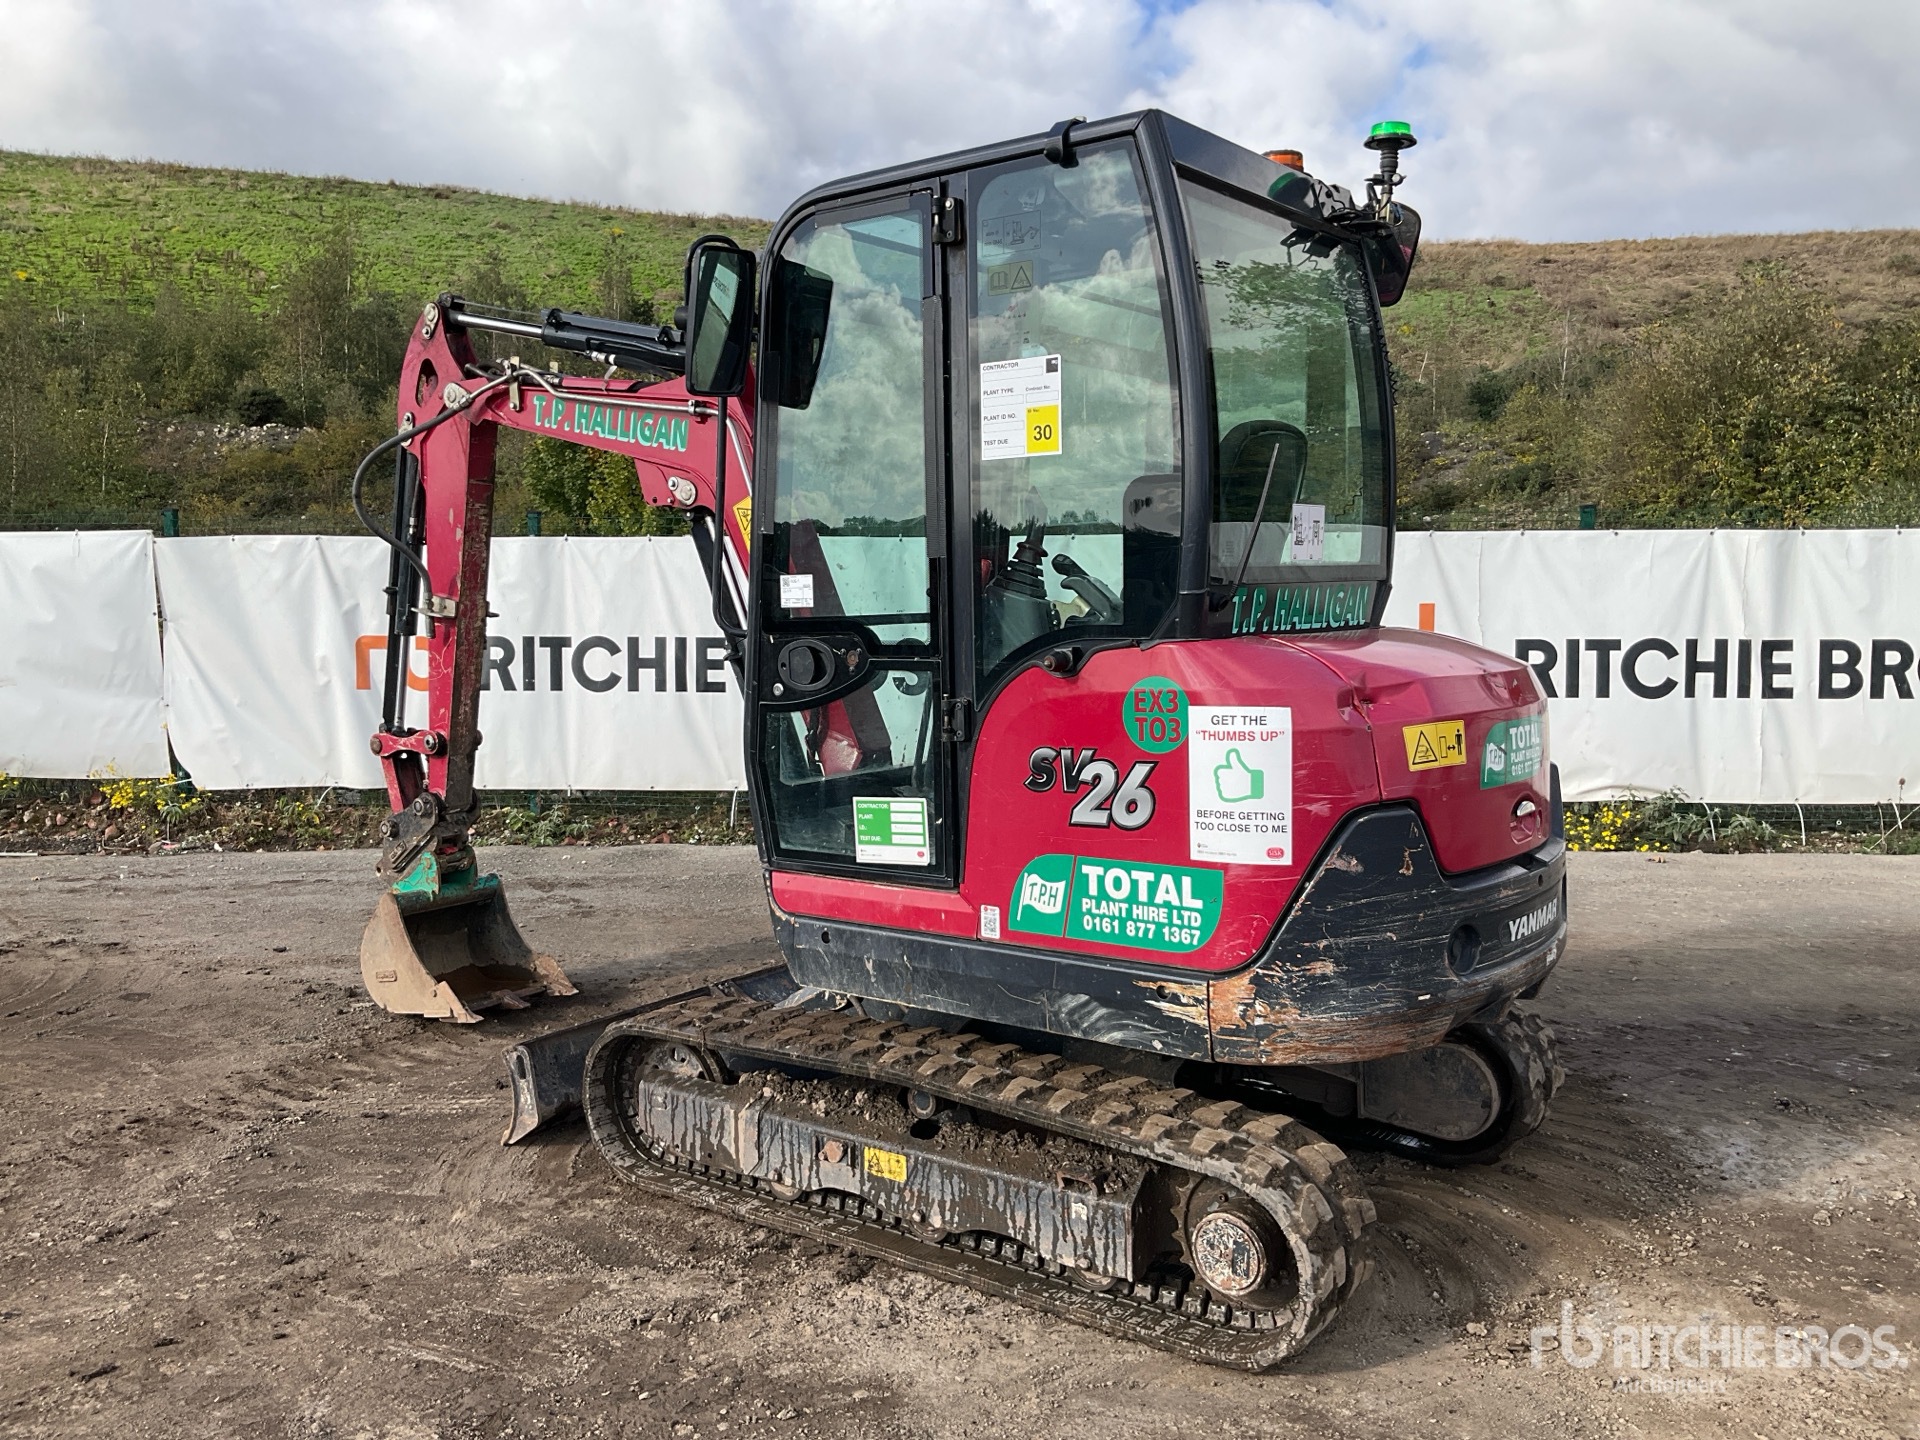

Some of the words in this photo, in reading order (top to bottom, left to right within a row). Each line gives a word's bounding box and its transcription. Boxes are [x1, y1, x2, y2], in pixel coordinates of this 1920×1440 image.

[983, 362, 1018, 371] CONTRACTOR
[534, 396, 570, 430] T.P.
[575, 403, 690, 452] HALLIGAN
[1033, 424, 1052, 441] 30
[1232, 586, 1270, 634] T.P.
[1272, 584, 1369, 632] HALLIGAN
[480, 636, 727, 692] RITCHIE
[1515, 638, 1794, 699] RITCHIE
[1818, 639, 1920, 699] BR
[1133, 688, 1178, 713] EX3
[1211, 715, 1237, 726] GET
[1241, 715, 1267, 726] THE
[1510, 723, 1539, 750] TOTAL
[1511, 750, 1525, 763] PLANT
[1195, 822, 1214, 832] TOO
[1216, 823, 1252, 833] CLOSE
[1254, 824, 1269, 833] TO
[1272, 824, 1288, 834] ME
[1197, 810, 1235, 820] BEFORE
[1238, 811, 1285, 821] GETTING
[1082, 865, 1204, 909] TOTAL
[1082, 898, 1128, 918] PLANT
[1132, 904, 1168, 922] HIRE
[1173, 910, 1201, 928] LTD
[1509, 897, 1557, 941] YANMAR
[1083, 915, 1119, 934] 0161
[1127, 922, 1155, 940] 877
[1163, 926, 1201, 946] 1367
